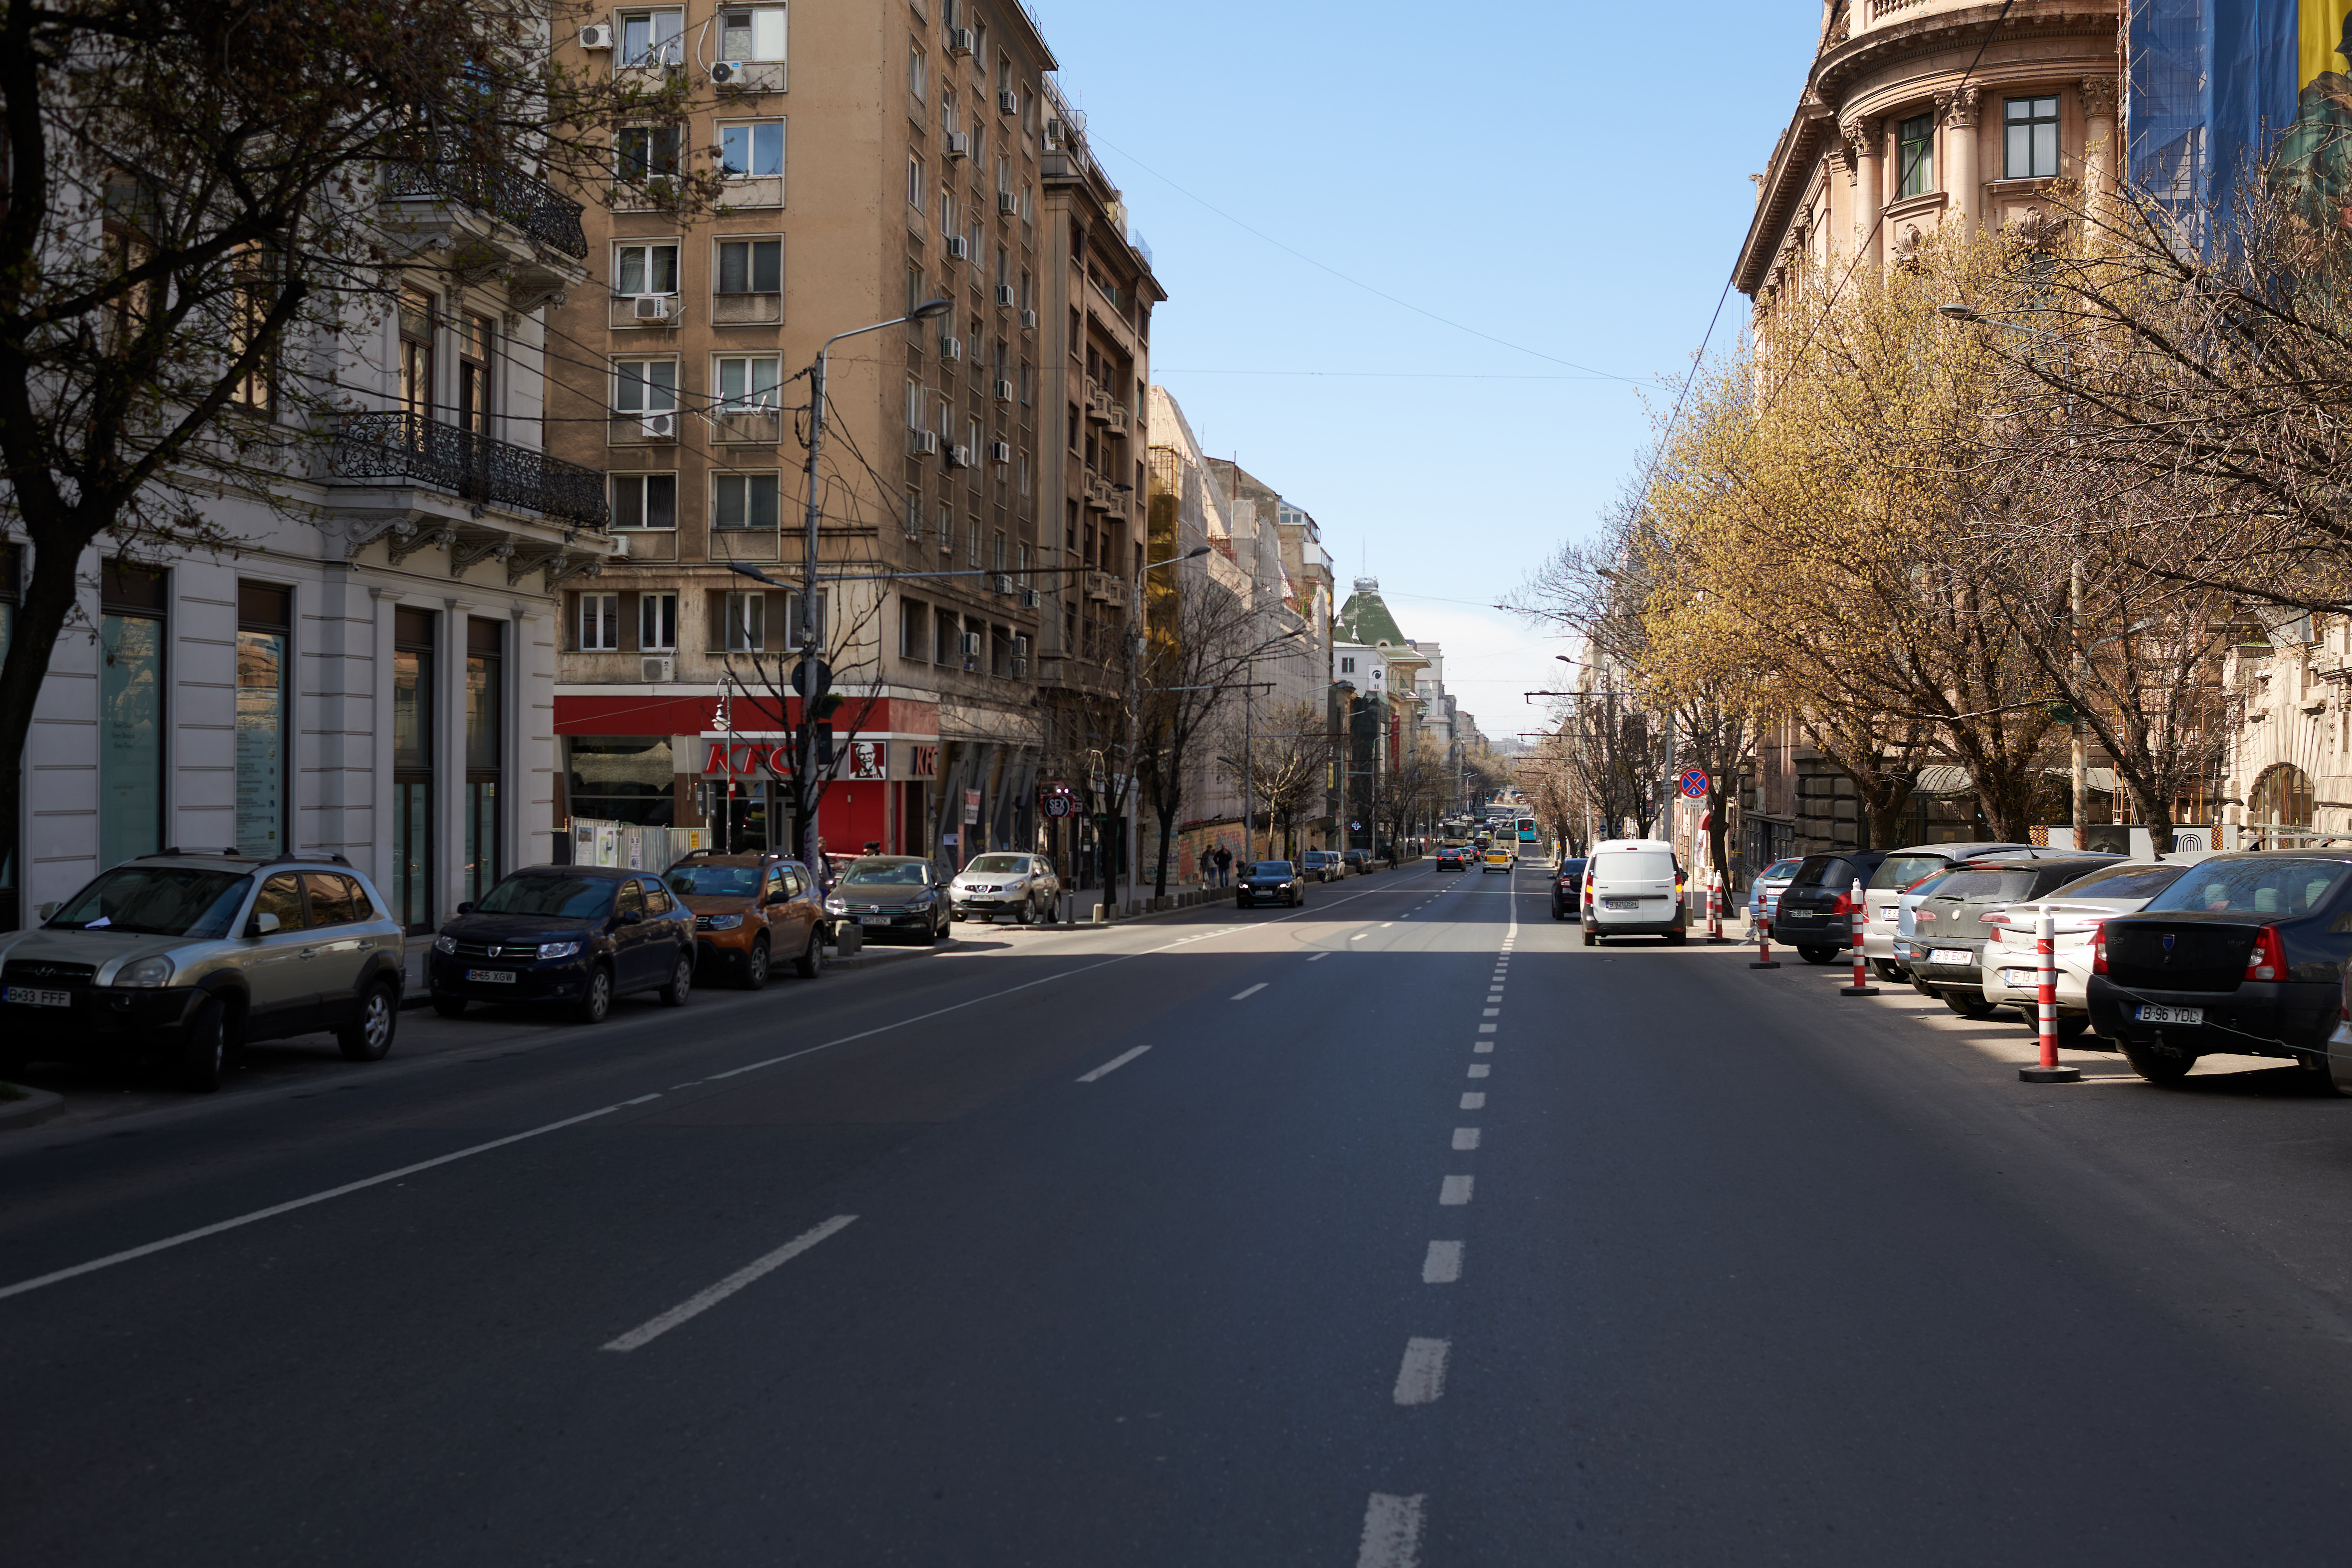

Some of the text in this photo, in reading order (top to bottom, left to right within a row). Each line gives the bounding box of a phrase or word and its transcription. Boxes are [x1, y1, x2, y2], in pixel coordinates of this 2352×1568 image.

[702, 744, 798, 774] KFC
[914, 746, 939, 775] KFC
[1049, 798, 1065, 809] SEX
[1936, 951, 1968, 962] B 16 EOM
[471, 971, 513, 981] B 65 XGW
[2011, 971, 2020, 982] IF
[2023, 972, 2030, 982] 13
[9, 988, 67, 1004] B 33 FFF
[2143, 1006, 2152, 1020] B
[2155, 1007, 2169, 1021] 96
[2174, 1008, 2197, 1023] YDL
